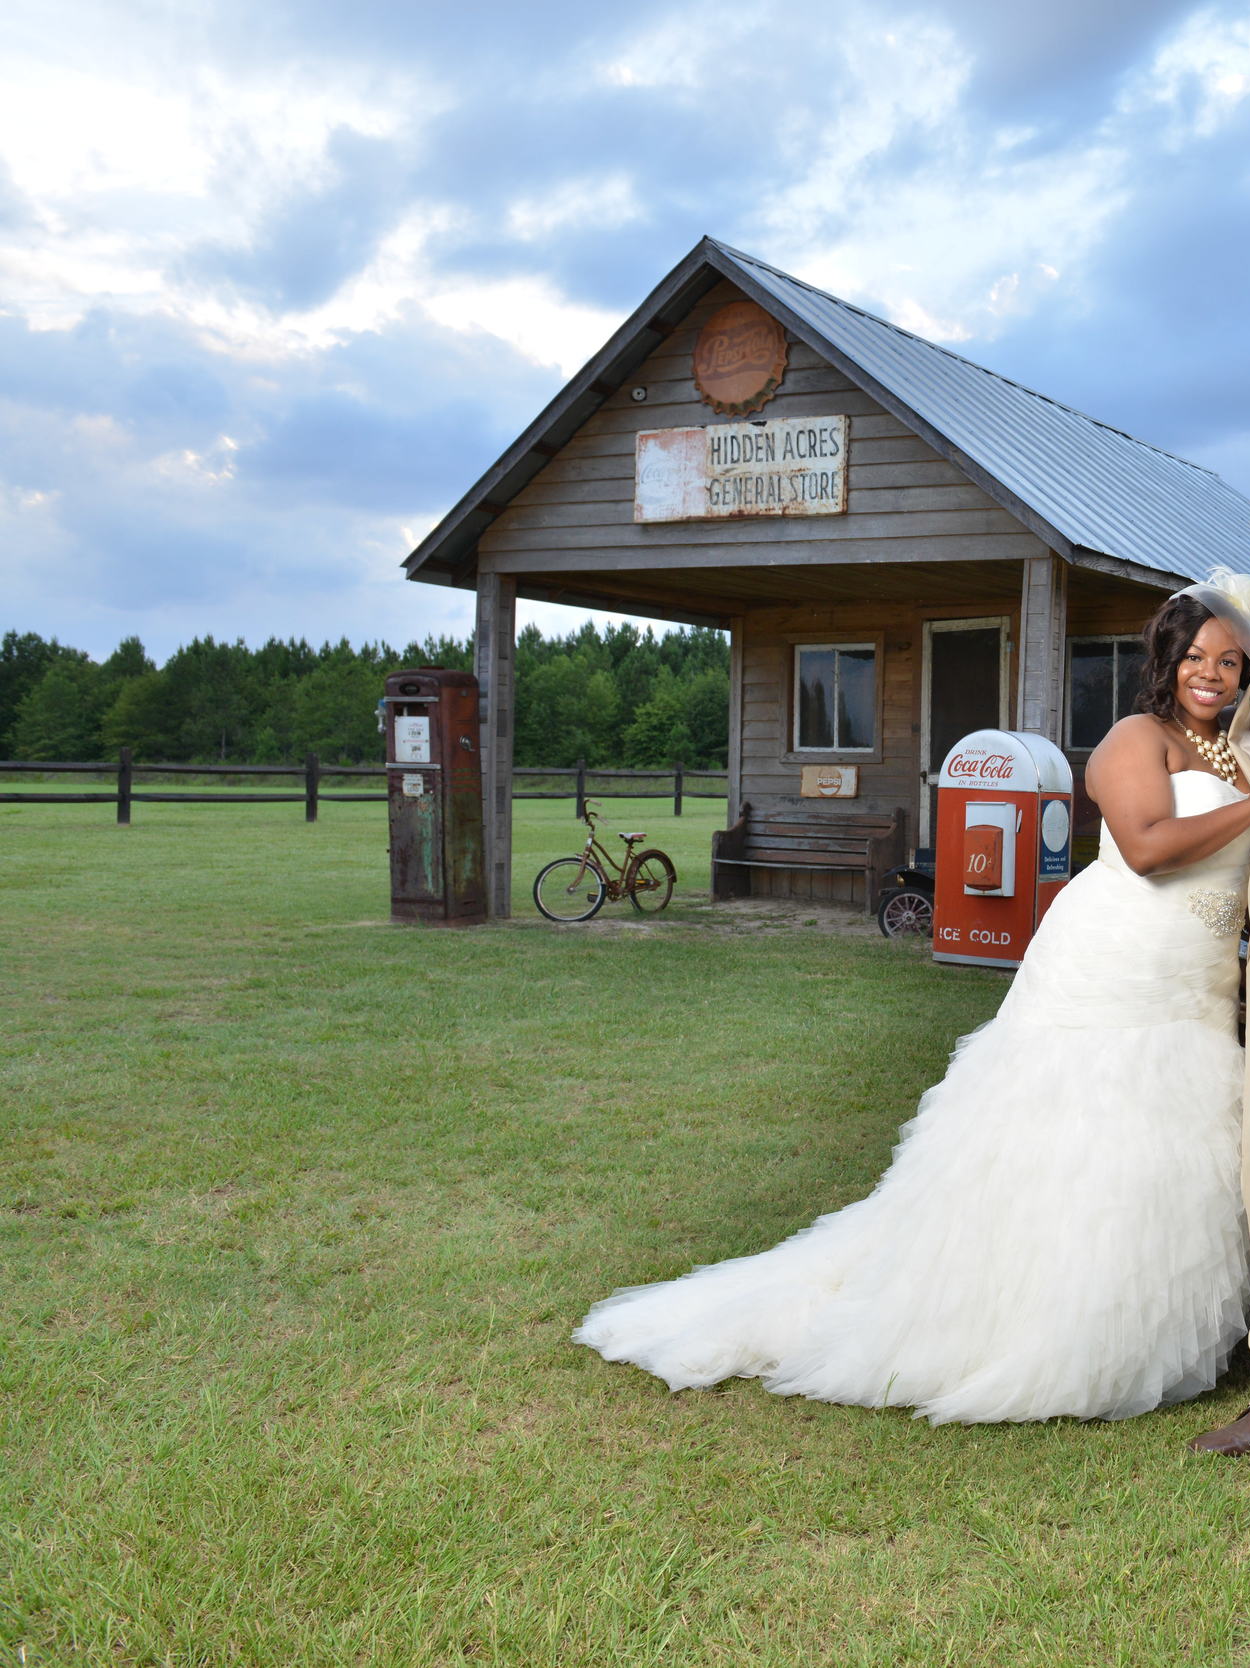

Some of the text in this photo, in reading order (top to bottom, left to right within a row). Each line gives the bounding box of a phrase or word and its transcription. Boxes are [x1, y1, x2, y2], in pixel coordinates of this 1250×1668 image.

[711, 427, 840, 465] HIDDEN ACRES
[709, 471, 838, 506] GENERAL STORE
[816, 777, 841, 785] PEPSI
[939, 927, 1011, 945] ICE COLD
